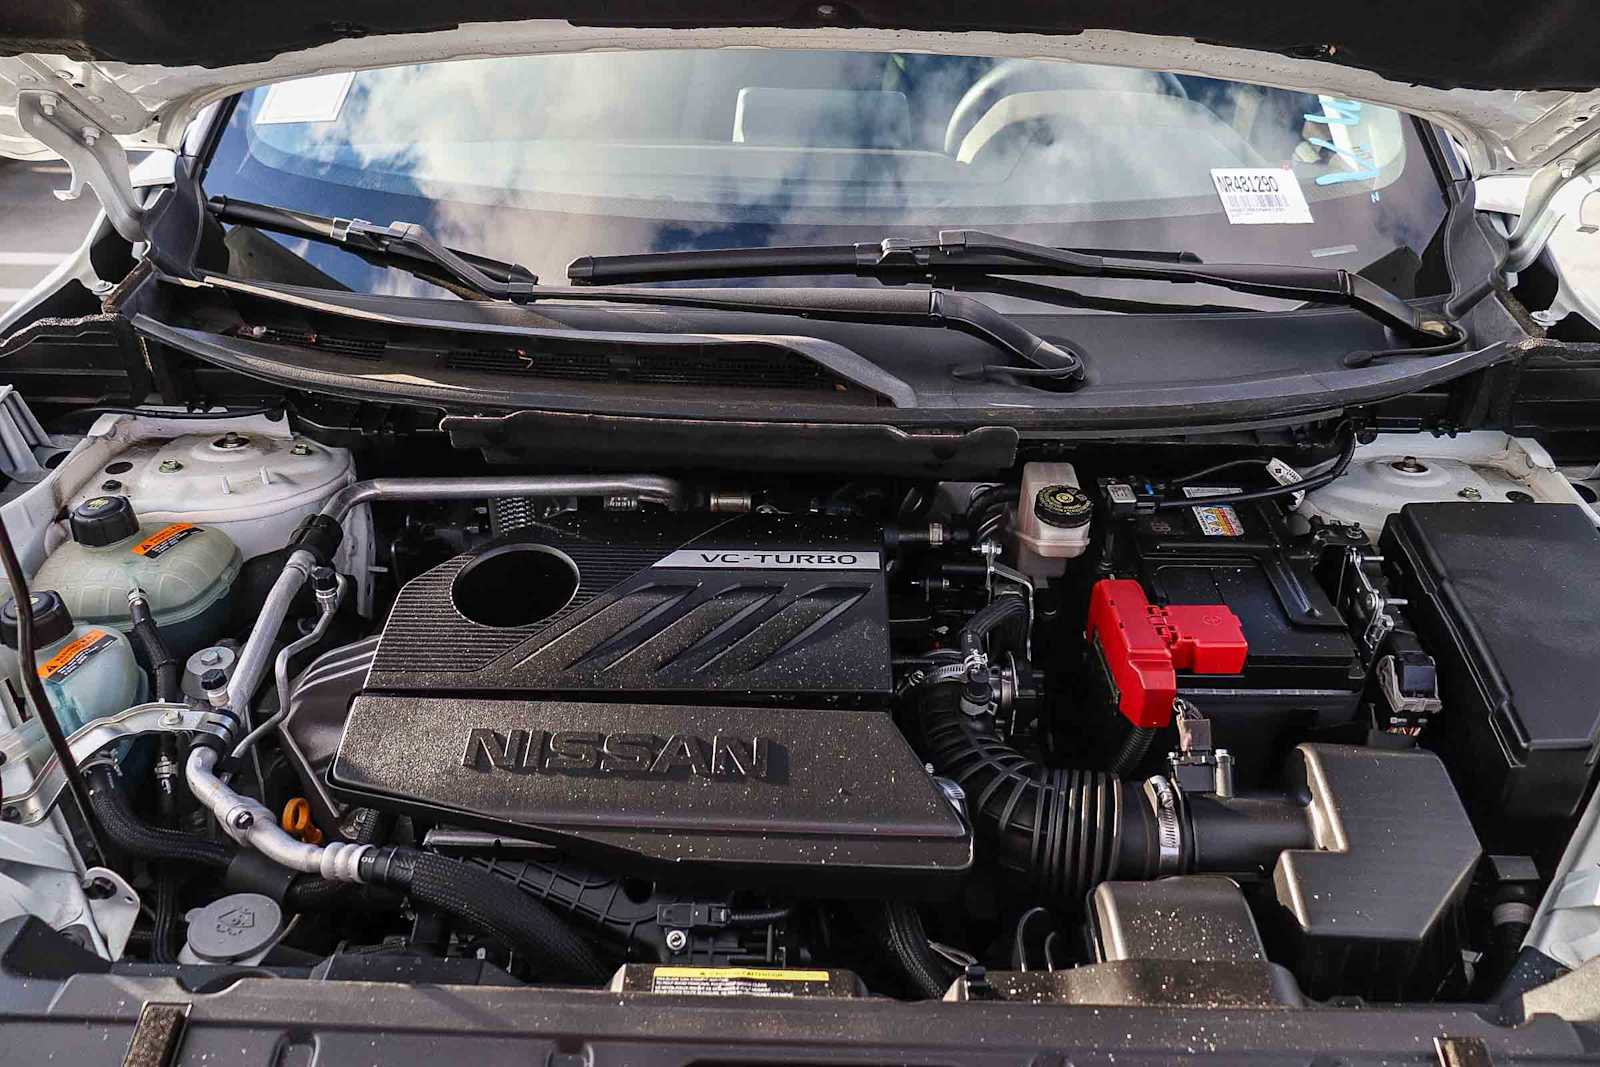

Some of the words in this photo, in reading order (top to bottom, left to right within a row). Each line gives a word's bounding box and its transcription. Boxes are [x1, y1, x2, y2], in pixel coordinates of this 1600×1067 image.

[1216, 175, 1279, 193] NR481290
[700, 553, 858, 565] VC-TURBO
[461, 728, 772, 778] NISSAN
